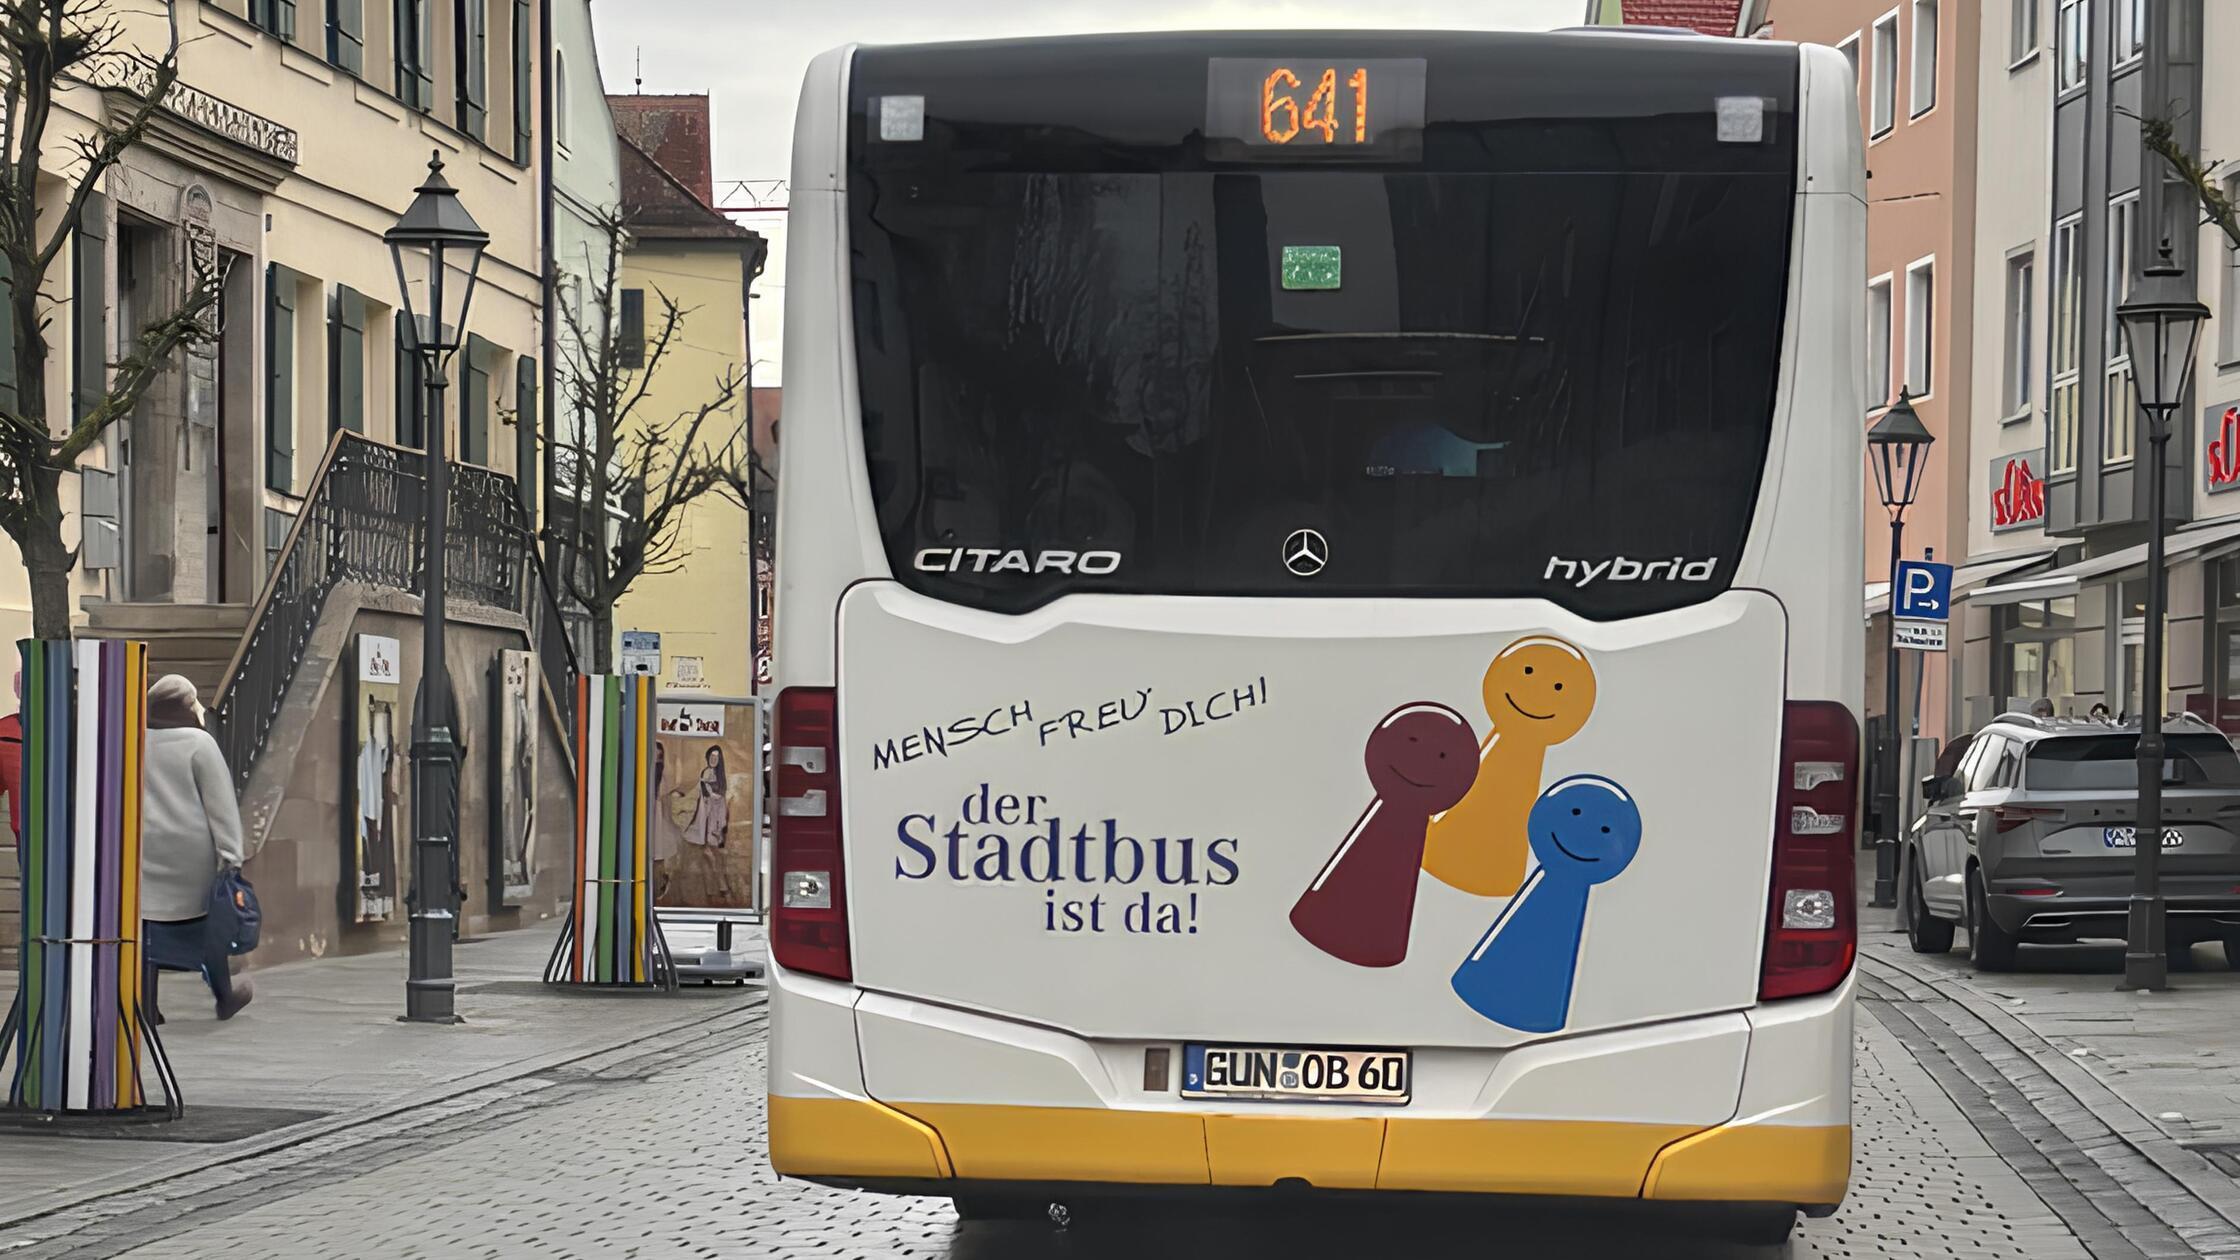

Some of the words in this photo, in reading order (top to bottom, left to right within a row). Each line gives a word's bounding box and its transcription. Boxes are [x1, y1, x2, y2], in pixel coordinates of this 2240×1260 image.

[1262, 68, 1367, 144] 641
[913, 547, 1122, 575] CITARO
[1543, 556, 1718, 588] hybrid
[1903, 568, 1935, 610] P
[872, 699, 1034, 771] MENSCH
[962, 783, 1048, 826] der
[895, 813, 1241, 886] Stadtbus
[1045, 889, 1107, 933] ist
[1124, 892, 1199, 935] da!
[1205, 1051, 1278, 1089] GUN
[1301, 1053, 1350, 1090] OB
[1357, 1055, 1404, 1092] 60
